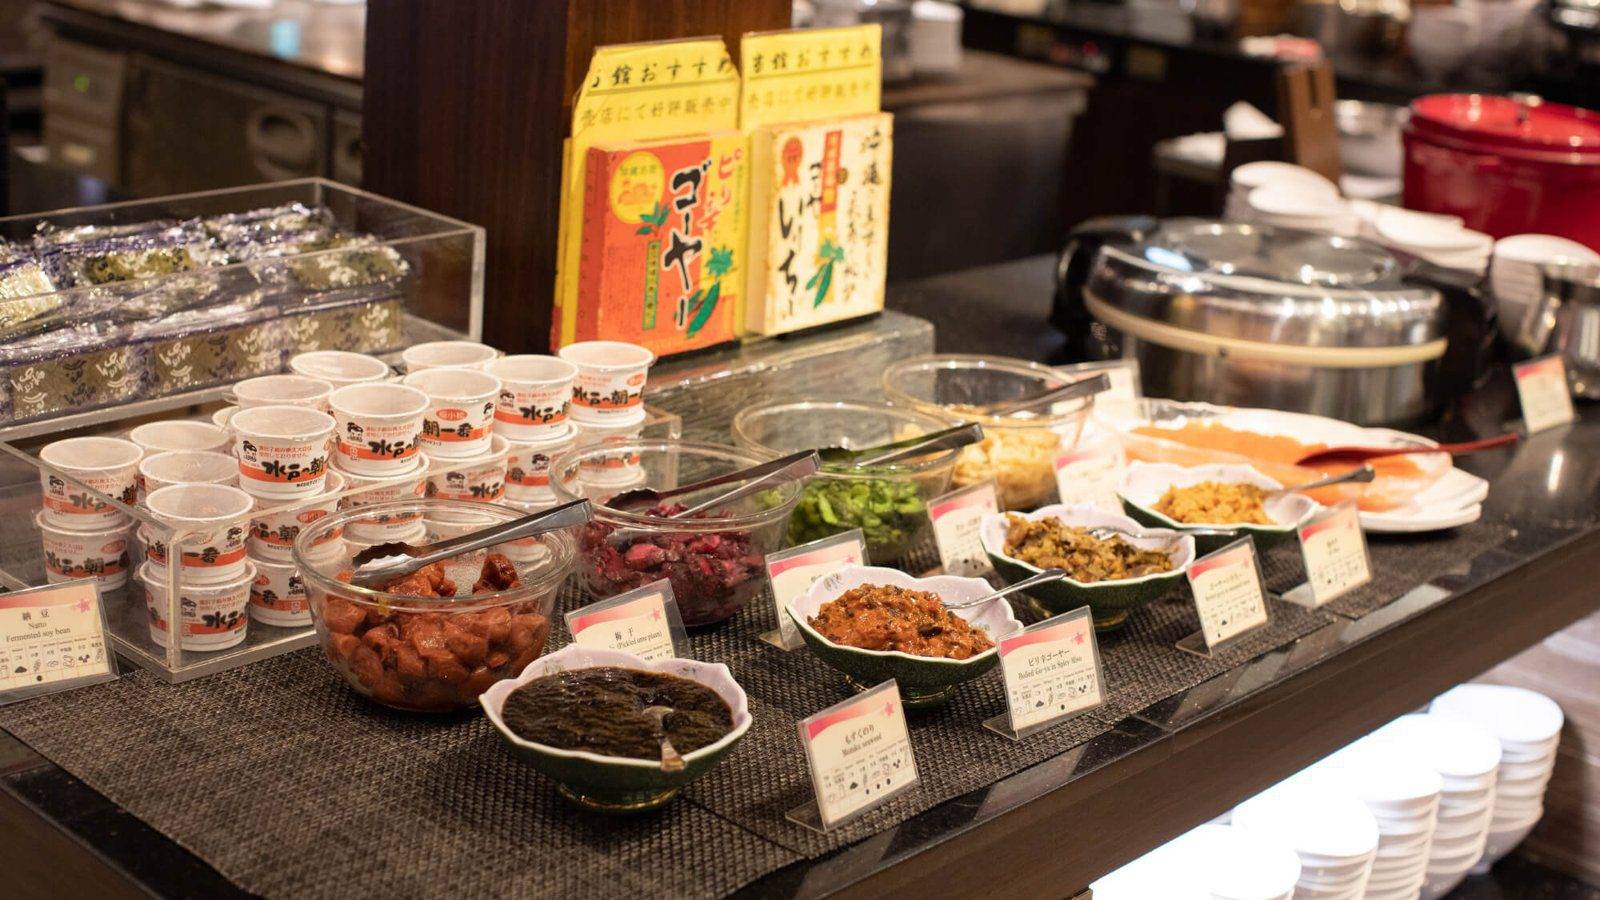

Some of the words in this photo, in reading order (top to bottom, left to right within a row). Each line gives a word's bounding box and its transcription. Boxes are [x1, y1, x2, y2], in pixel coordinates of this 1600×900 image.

[664, 160, 712, 327] ゴーヤー
[6, 631, 42, 642] Fermented
[42, 630, 54, 638] soy
